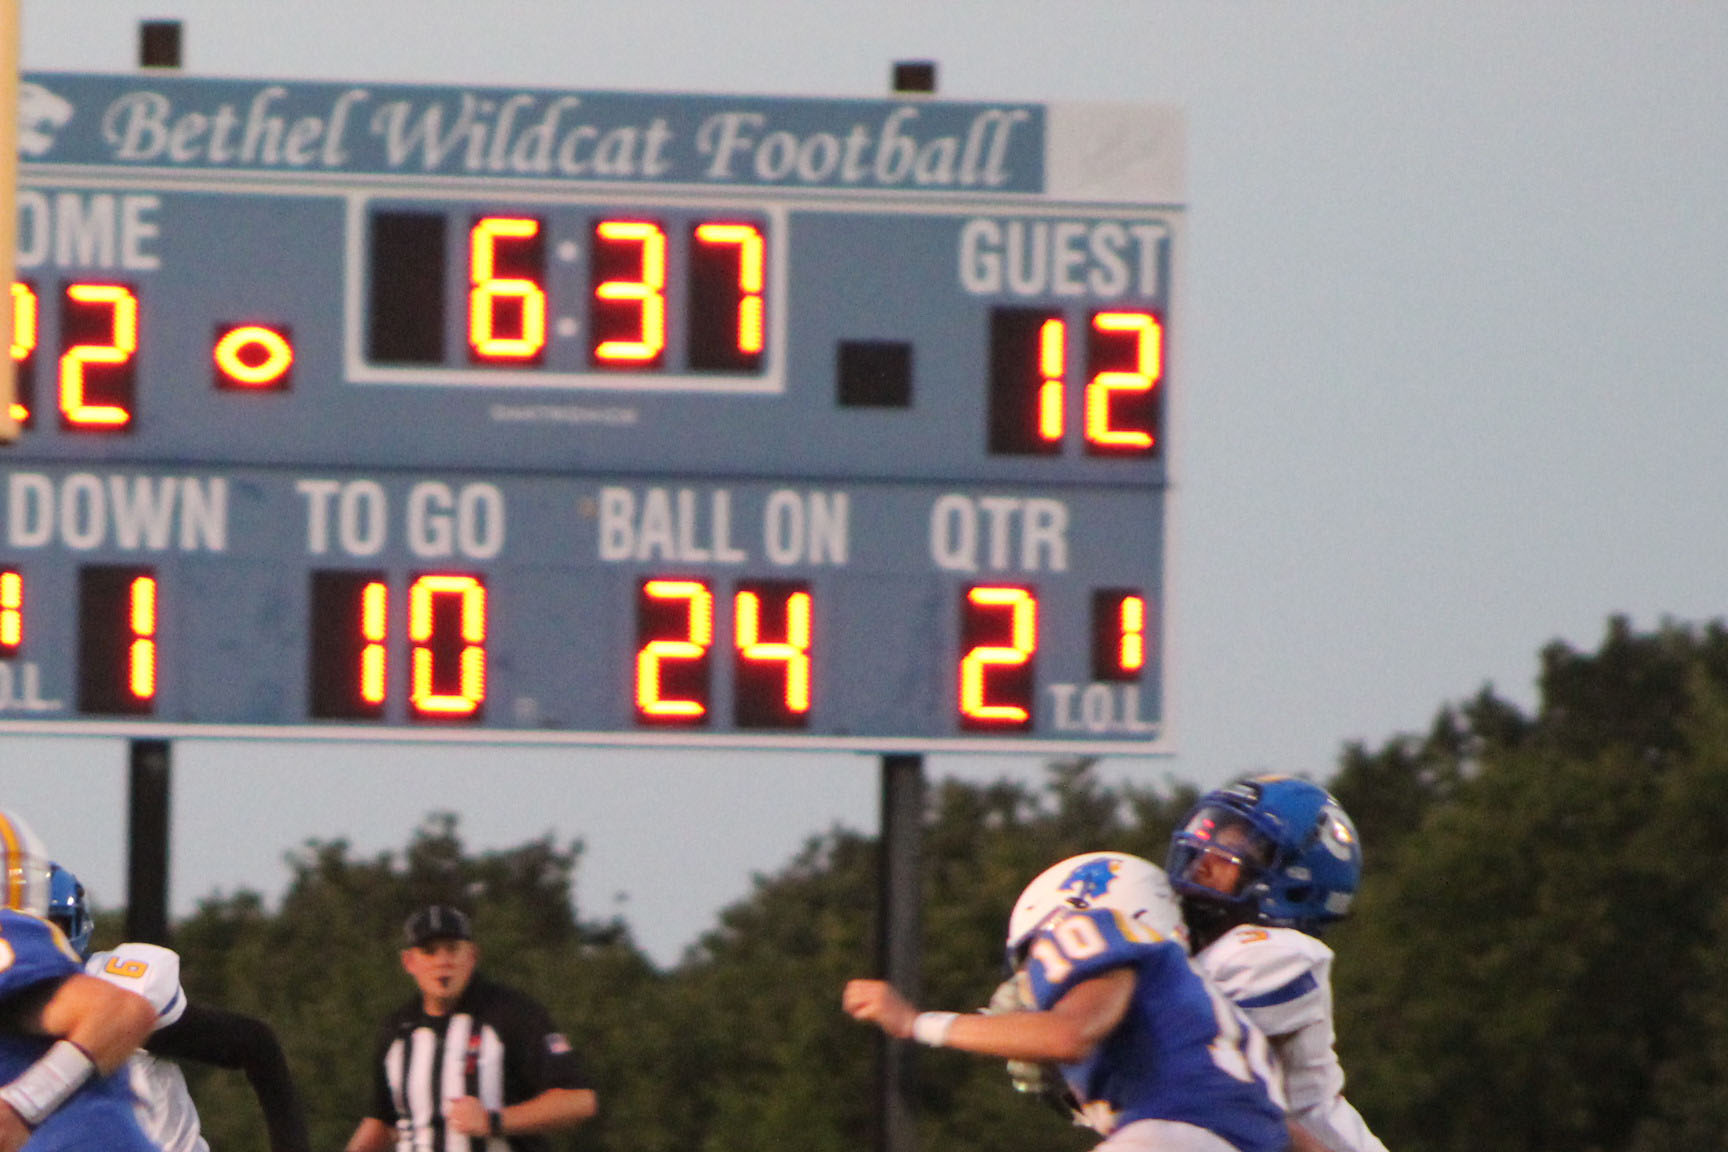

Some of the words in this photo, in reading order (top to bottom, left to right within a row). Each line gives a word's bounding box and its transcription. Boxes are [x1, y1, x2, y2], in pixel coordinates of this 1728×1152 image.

[102, 86, 368, 167] Bethel
[372, 92, 673, 177] Wildcat
[696, 107, 1029, 187] Football
[470, 216, 766, 361] 6:37
[958, 217, 1168, 297] GUEST
[1038, 312, 1163, 448] 12
[7, 472, 229, 552] DOWN
[297, 479, 387, 557] TO
[407, 481, 505, 560] GO
[597, 487, 748, 563] BALL
[764, 490, 851, 566] ON
[930, 494, 1069, 572] QTR
[129, 575, 157, 699] 1
[361, 574, 487, 714] 10
[636, 579, 812, 715] 24
[960, 585, 1039, 722] 2
[1119, 594, 1146, 671] 1
[1031, 912, 1109, 984] 10
